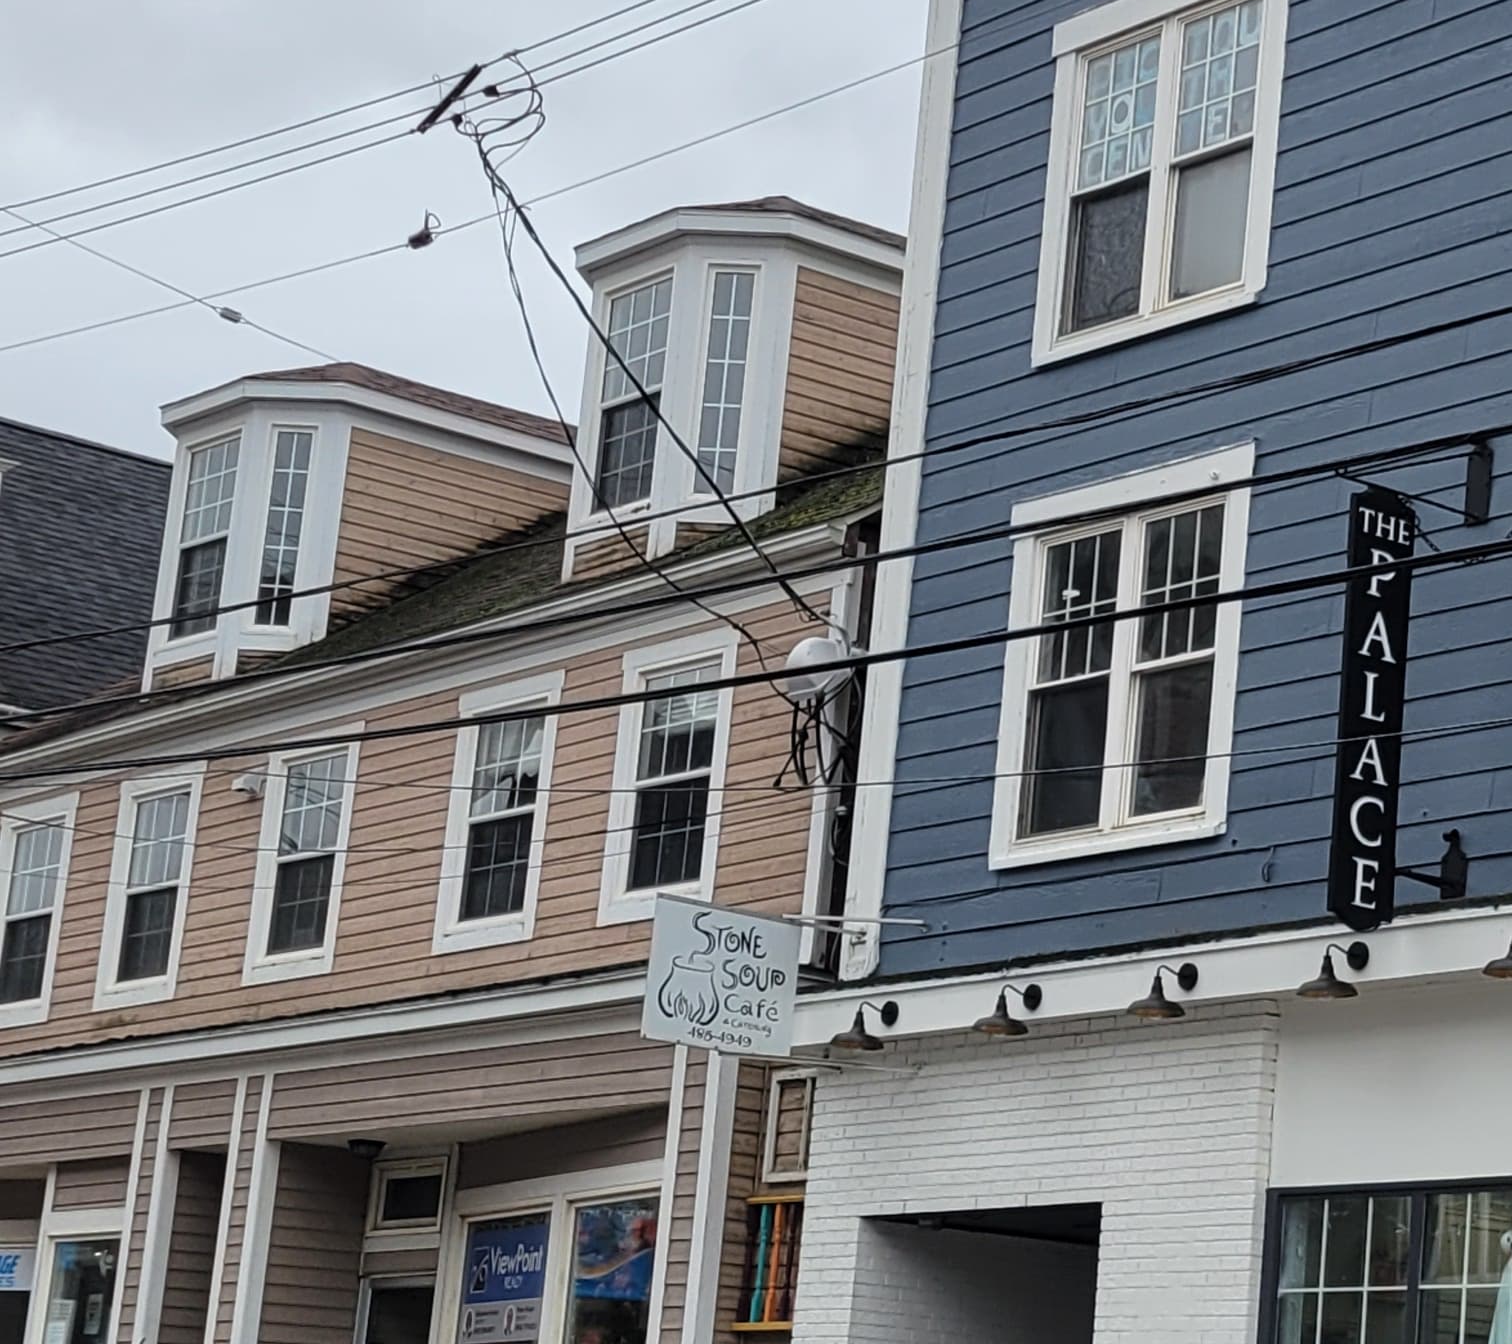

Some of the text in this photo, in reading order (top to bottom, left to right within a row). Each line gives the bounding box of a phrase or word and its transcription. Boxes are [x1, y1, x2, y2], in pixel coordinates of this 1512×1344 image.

[1358, 506, 1411, 545] THE
[1349, 547, 1397, 910] PALACE
[692, 911, 767, 959] STONE
[721, 959, 786, 992] SOUP
[724, 993, 780, 1022] Café
[687, 1026, 752, 1048] 485-4949
[490, 1243, 544, 1275] ViewPoint
